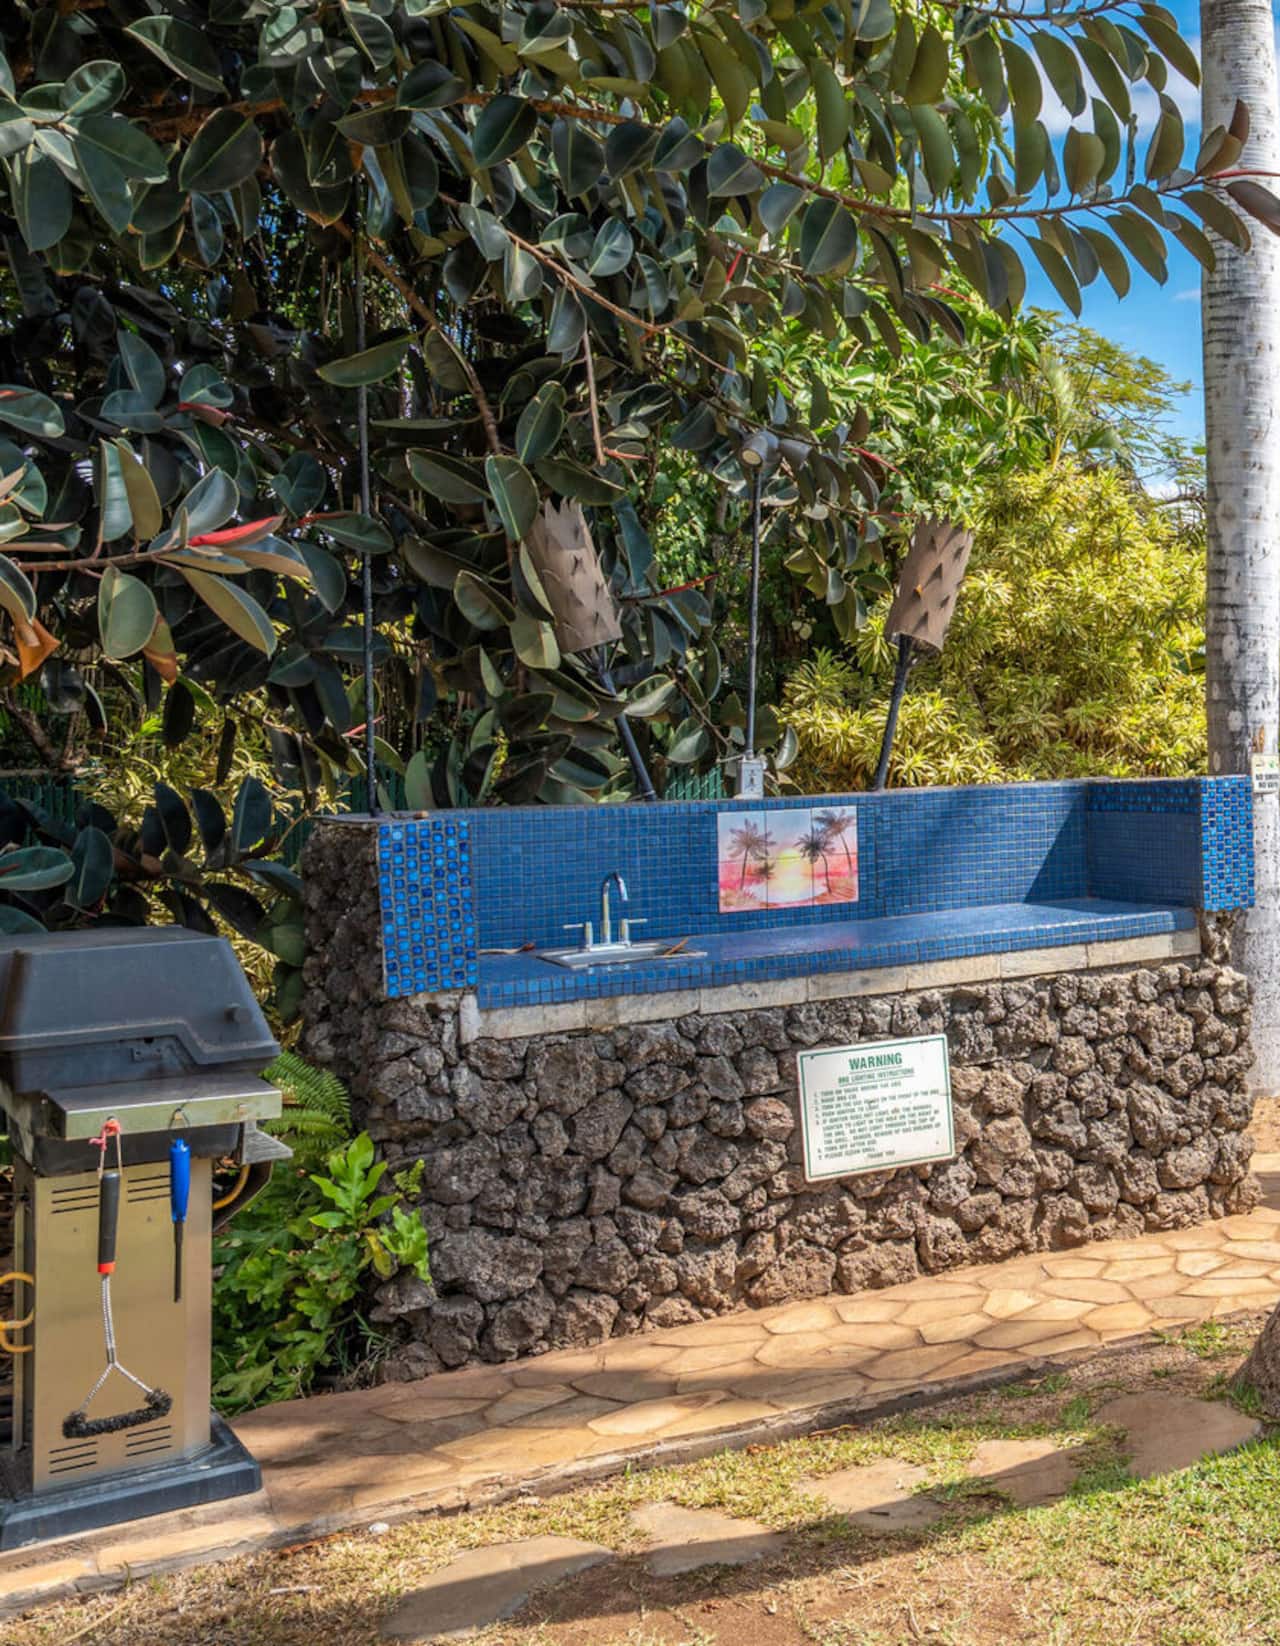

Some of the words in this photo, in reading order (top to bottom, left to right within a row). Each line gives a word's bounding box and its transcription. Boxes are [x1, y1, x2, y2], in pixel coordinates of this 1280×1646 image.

[848, 1052, 902, 1071] WARNING
[851, 1072, 875, 1082] LIGHTING
[878, 1067, 914, 1079] INSTRUCTIONS
